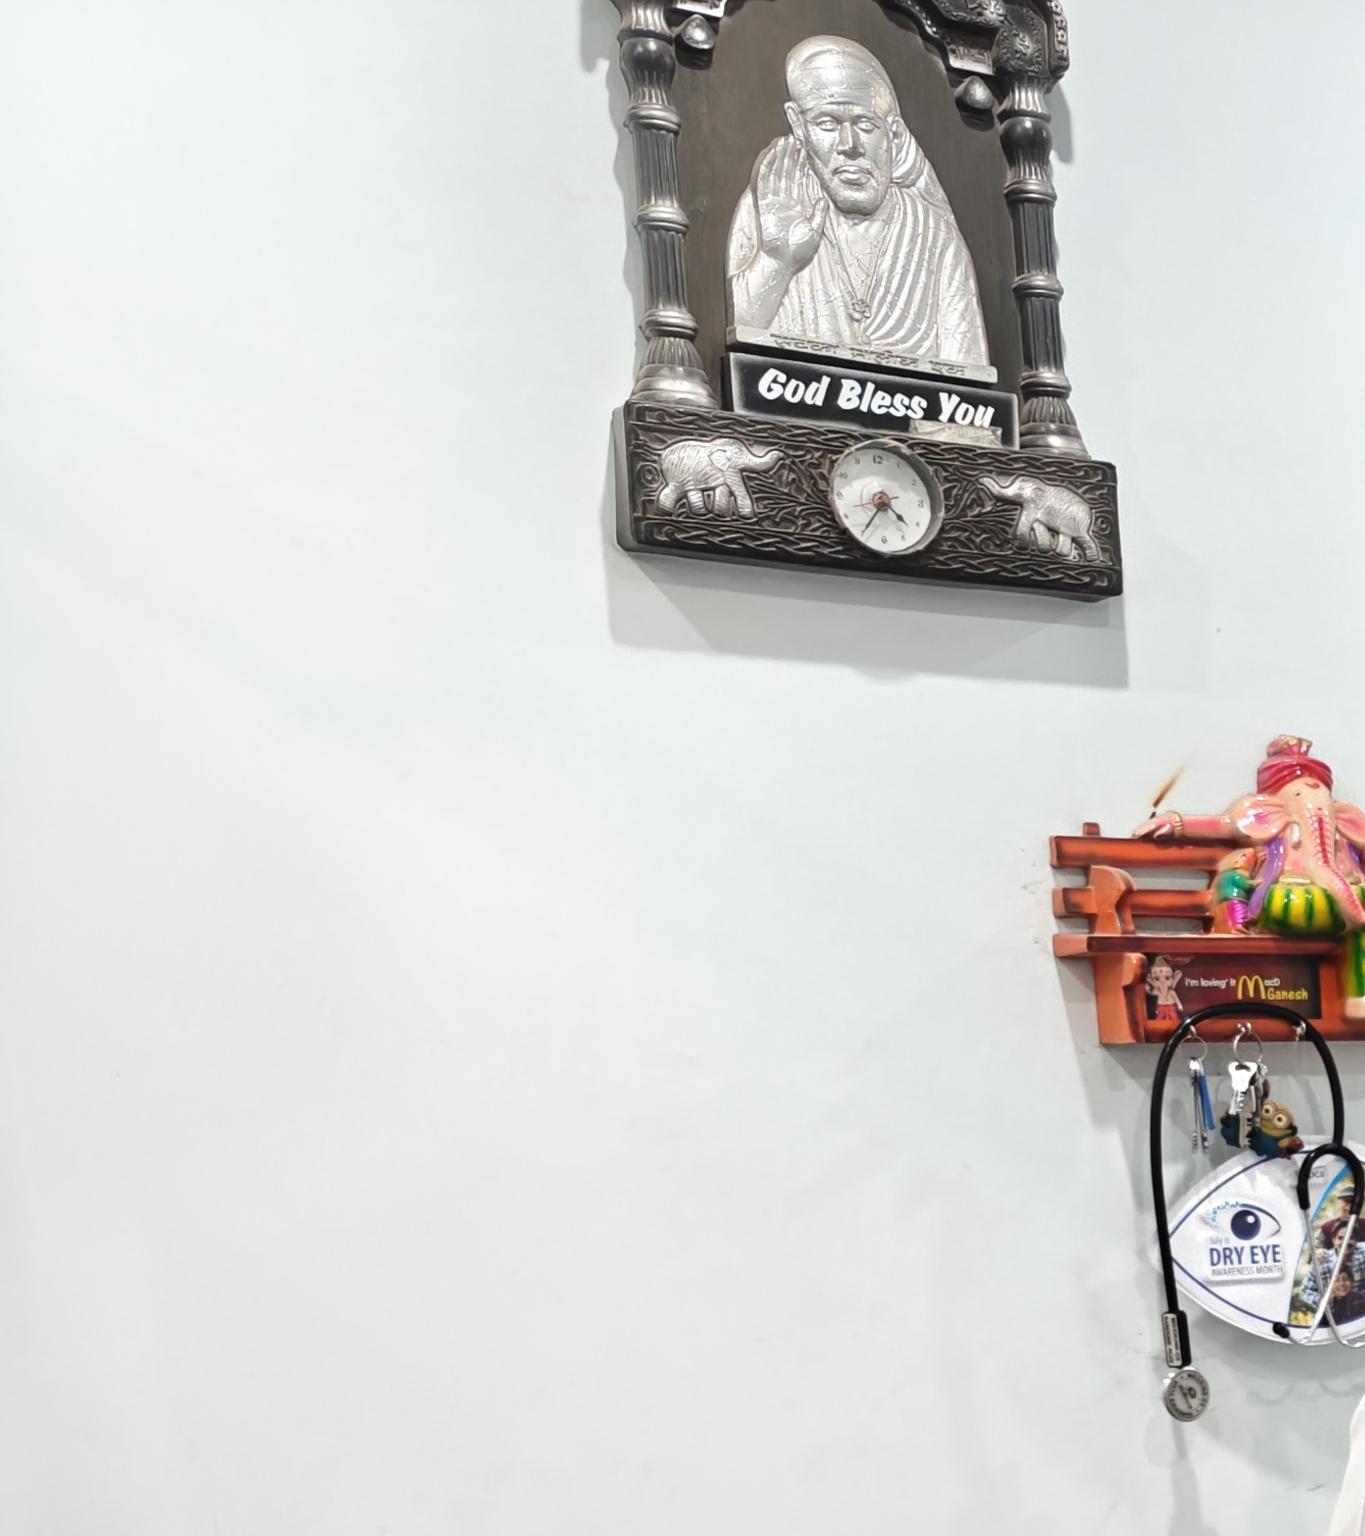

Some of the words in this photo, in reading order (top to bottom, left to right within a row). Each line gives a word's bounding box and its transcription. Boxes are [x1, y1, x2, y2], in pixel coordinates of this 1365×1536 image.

[758, 368, 831, 406] God
[837, 377, 928, 420] Bless
[938, 391, 995, 428] You
[1267, 987, 1309, 1001] Ganesh
[1209, 1246, 1245, 1267] DRY
[1250, 1244, 1282, 1265] EYE
[1211, 1264, 1255, 1277] AWARENESS
[1256, 1264, 1283, 1275] MONTH
